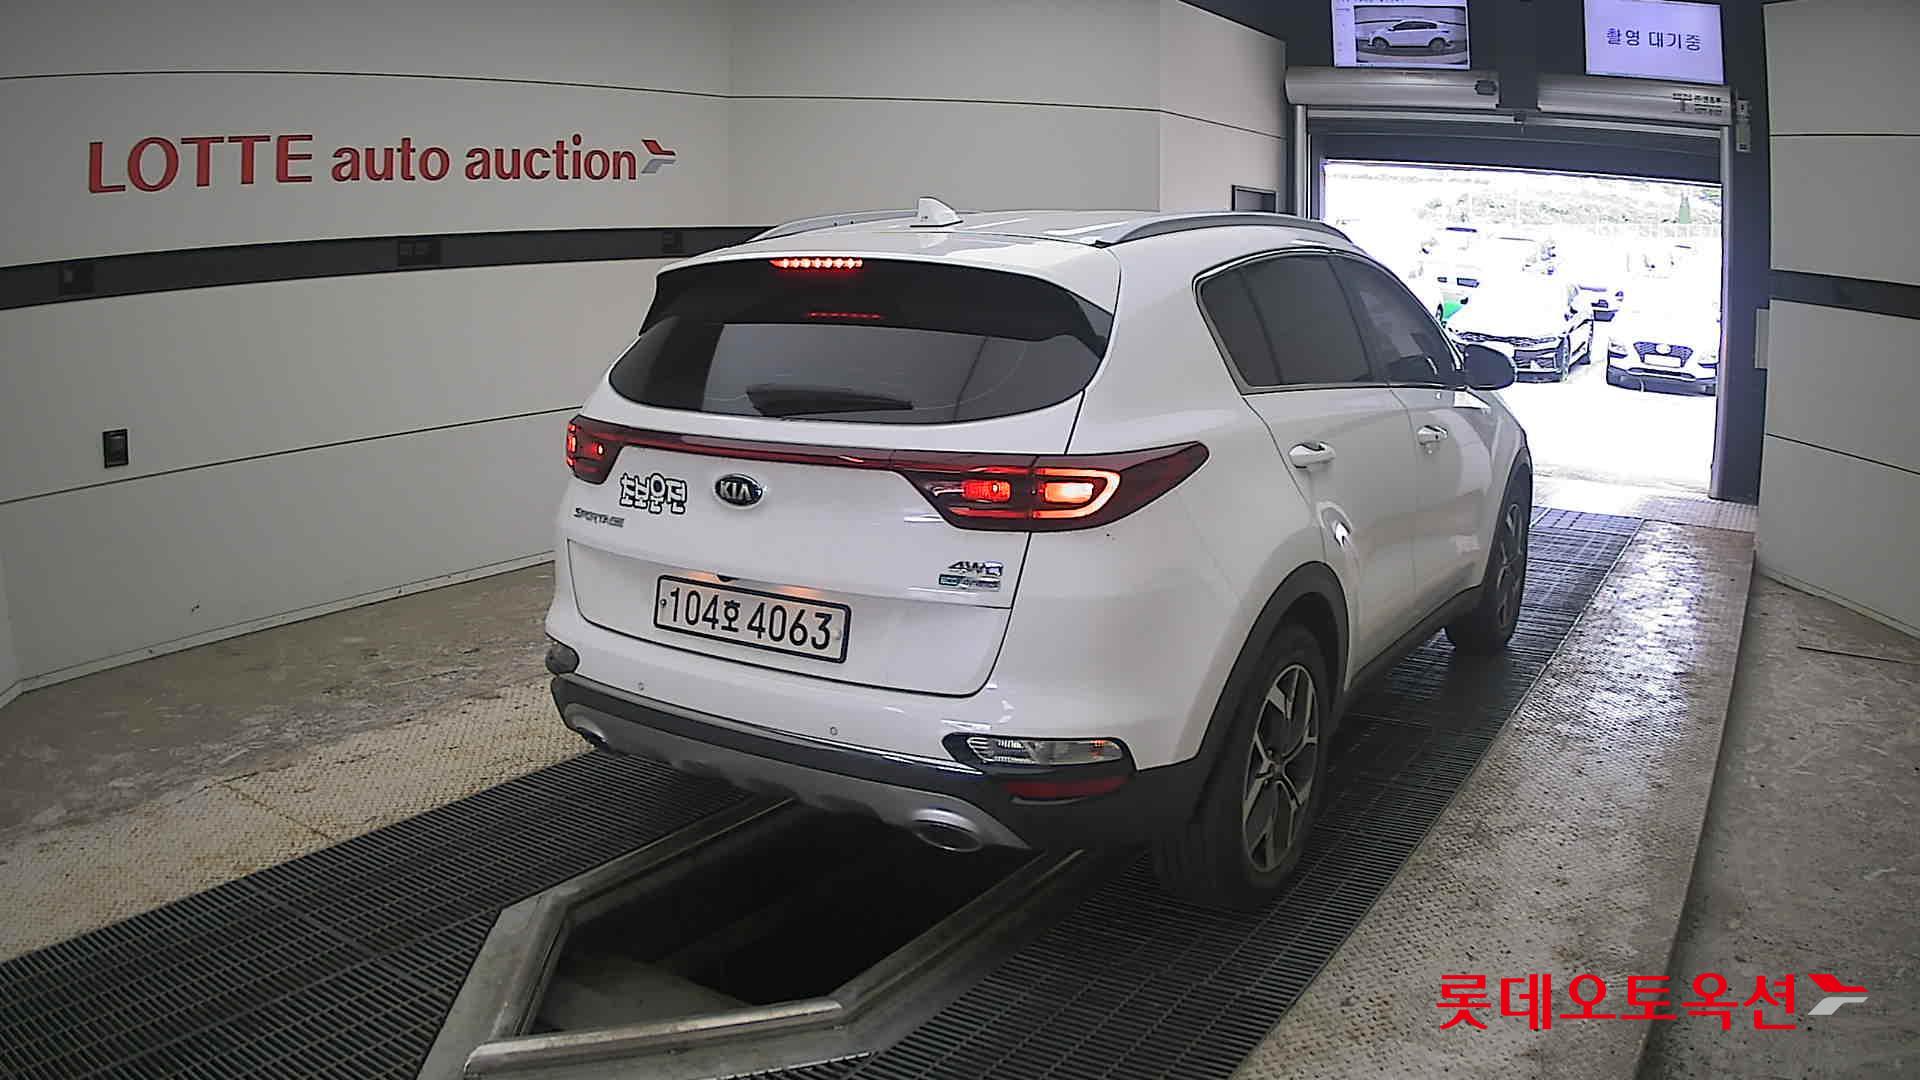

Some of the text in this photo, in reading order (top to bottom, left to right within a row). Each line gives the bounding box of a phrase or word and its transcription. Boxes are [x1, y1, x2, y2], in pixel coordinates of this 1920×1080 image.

[1607, 27, 1701, 51] 촬영 대기중
[88, 133, 637, 194] LOTTE auto auction
[619, 472, 688, 515] 초보운전
[719, 480, 752, 501] KIA
[669, 587, 832, 651] 104호 4063
